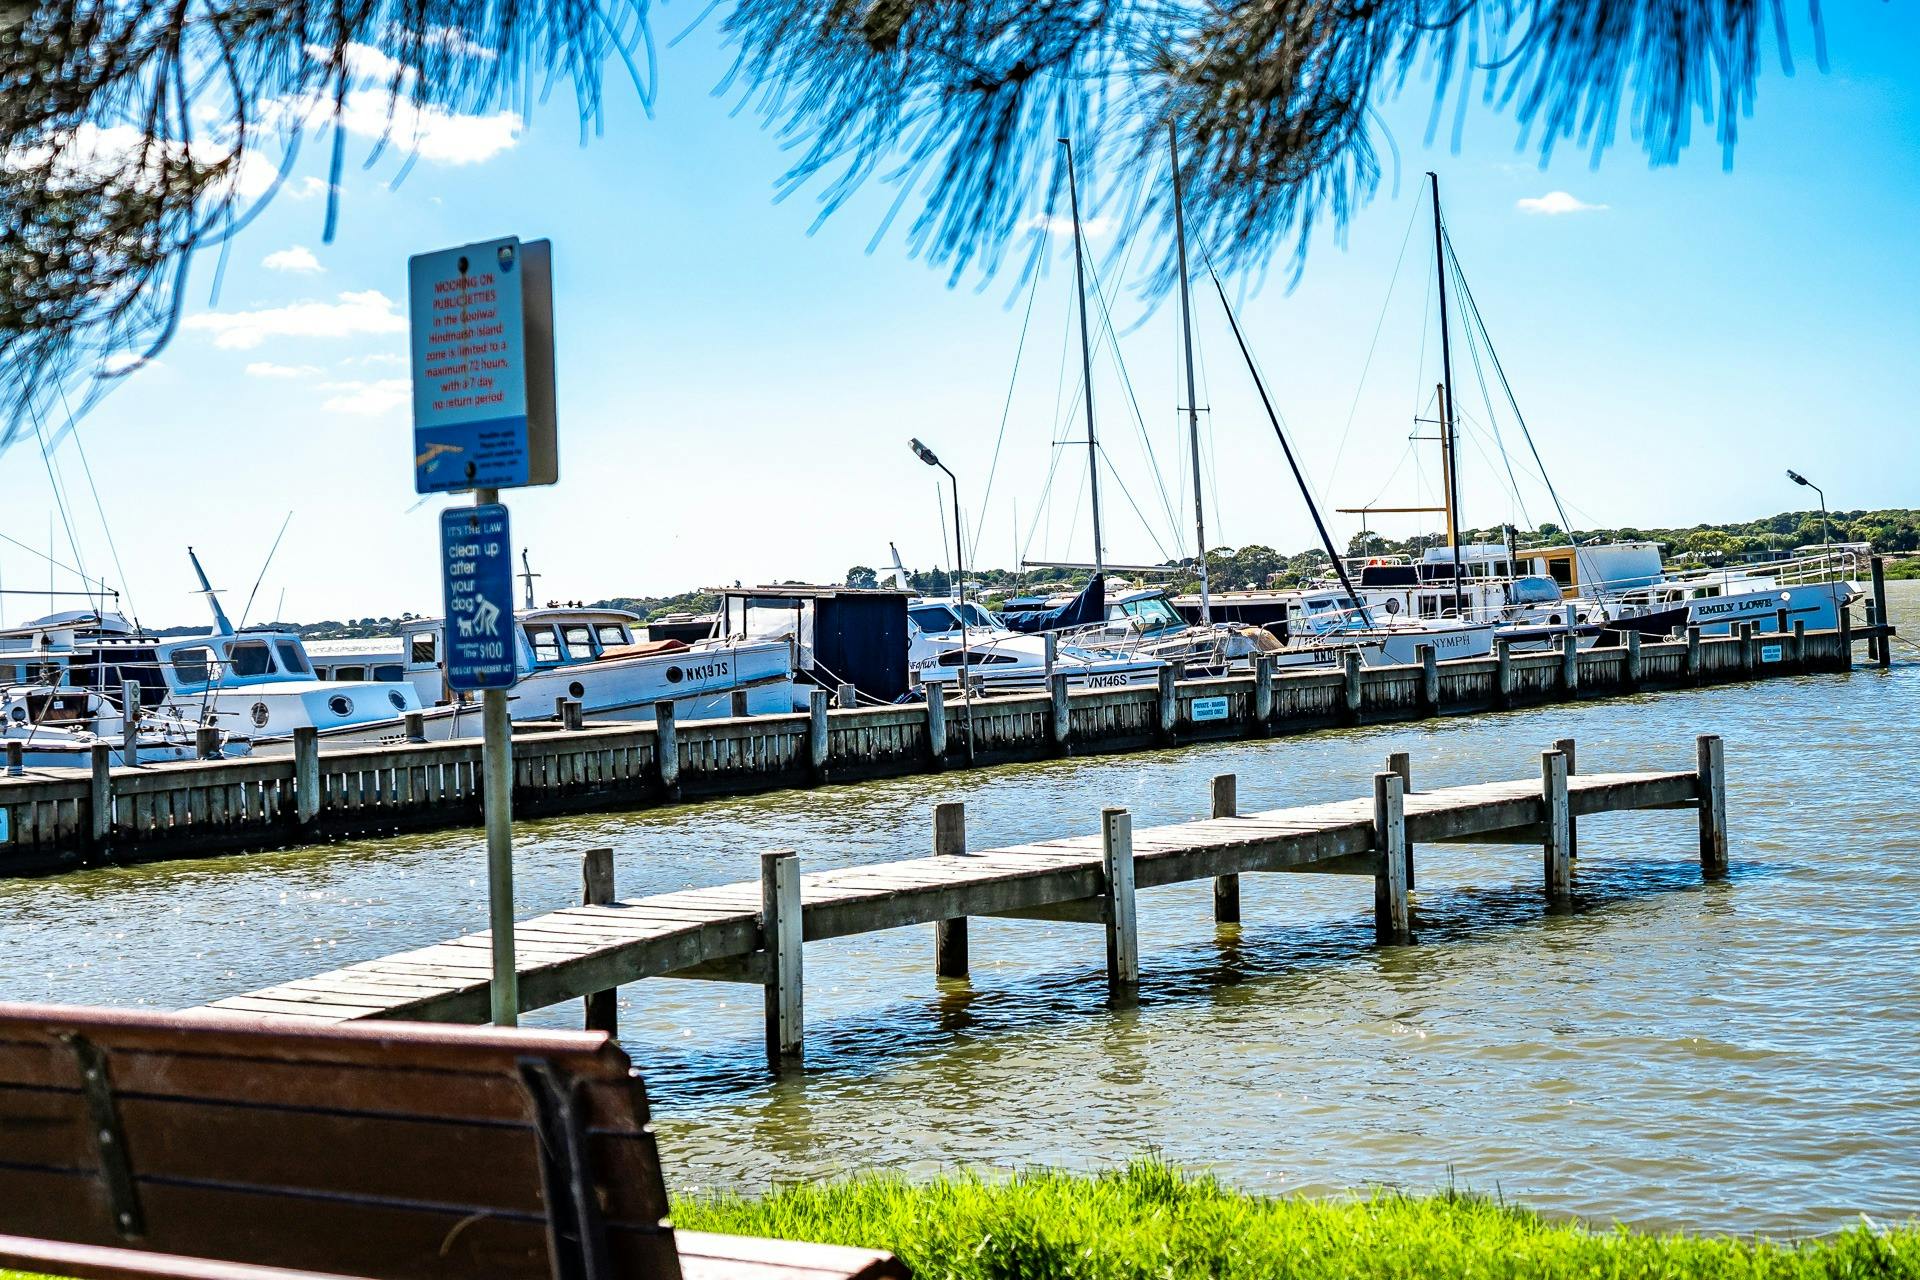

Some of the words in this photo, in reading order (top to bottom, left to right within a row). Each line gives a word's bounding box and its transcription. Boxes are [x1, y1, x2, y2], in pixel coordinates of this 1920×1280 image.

[480, 273, 494, 285] ON
[433, 295, 462, 310] PUBLIC
[433, 316, 441, 328] in
[444, 314, 458, 326] the
[429, 328, 474, 344] Hindmarsh
[476, 323, 504, 336] Island
[426, 351, 446, 362] zone
[448, 349, 456, 358] is
[458, 344, 487, 356] limited
[490, 342, 498, 352] to
[501, 342, 506, 351] a
[425, 364, 467, 378] maximum
[470, 360, 480, 371] 72
[441, 380, 460, 392] with
[463, 380, 468, 390] a
[478, 376, 493, 389] day
[432, 400, 444, 411] no
[446, 396, 472, 408] return
[475, 391, 504, 408] period
[464, 524, 481, 534] THE
[484, 522, 502, 534] LAW
[448, 542, 480, 558] clean
[484, 542, 500, 558] up
[449, 560, 476, 576] after
[450, 580, 476, 596] your
[451, 596, 474, 612] dog
[1698, 602, 1734, 616] EMILY
[1738, 598, 1772, 610] LOWE
[1432, 634, 1470, 648] NYMPH
[480, 640, 503, 660] $100
[463, 666, 472, 674] CAT
[473, 664, 502, 674] MANAGEMENT
[503, 664, 512, 672] ACT
[1088, 674, 1128, 688] VN146S
